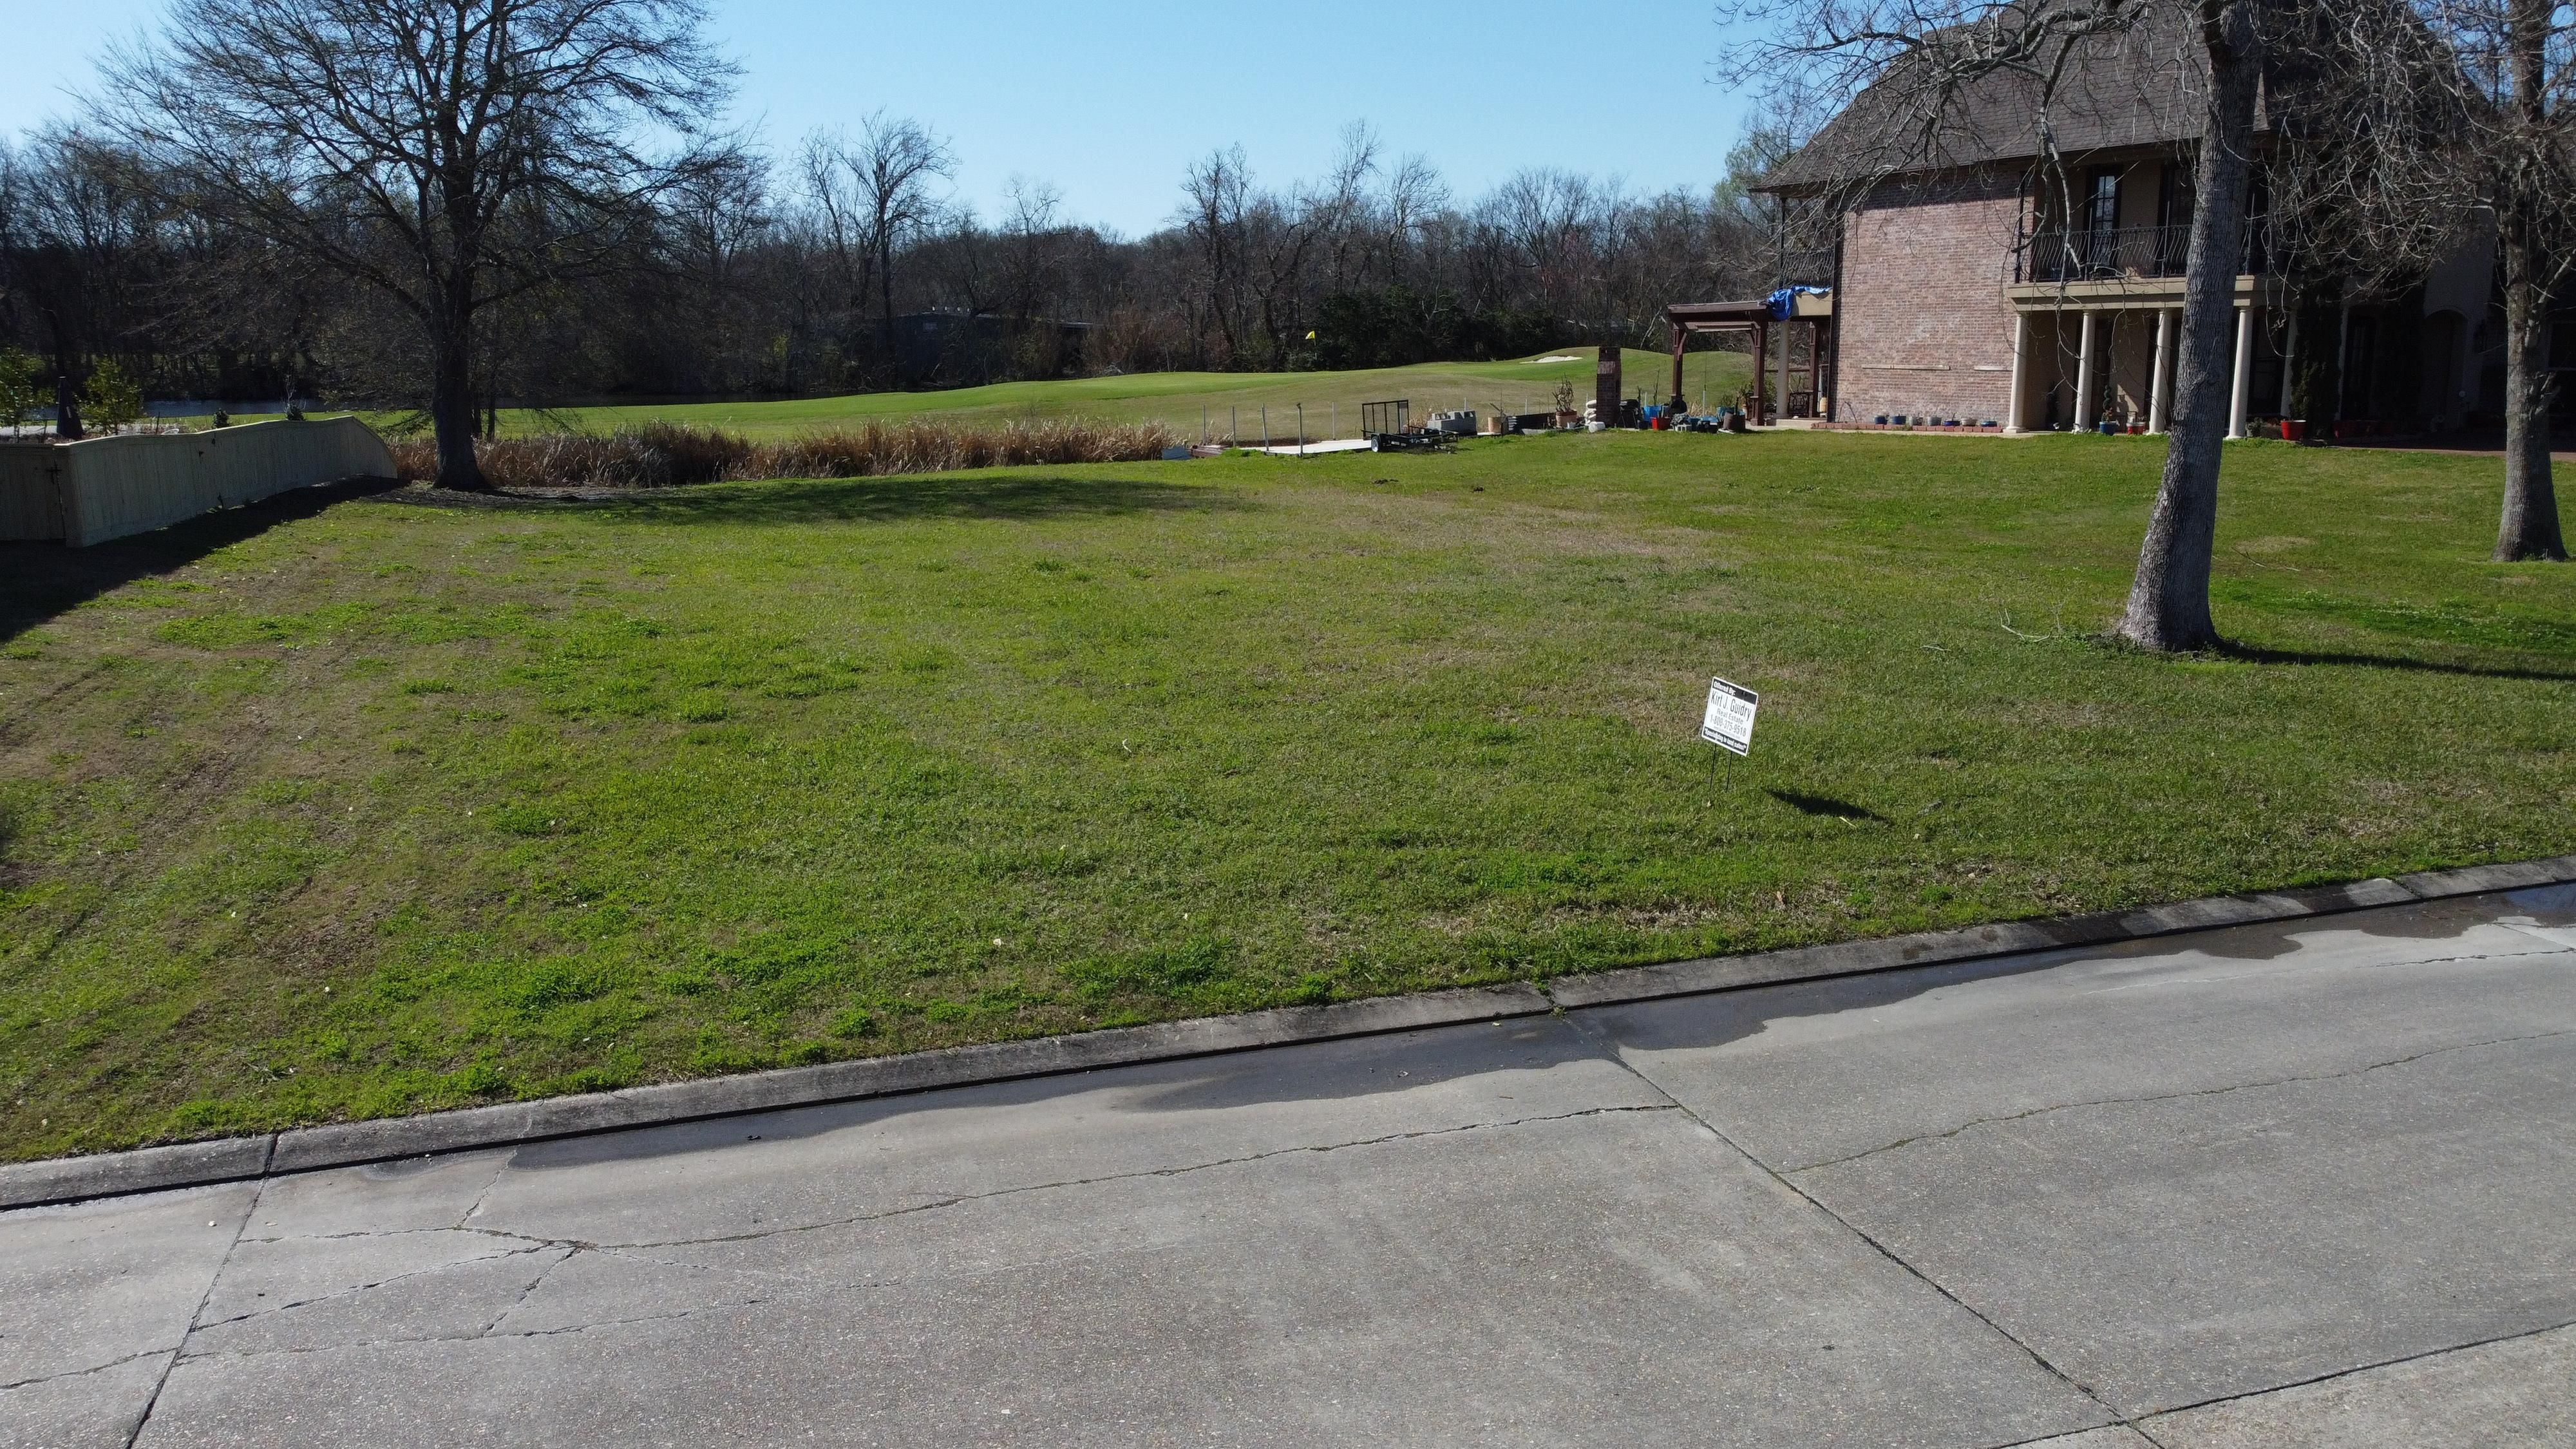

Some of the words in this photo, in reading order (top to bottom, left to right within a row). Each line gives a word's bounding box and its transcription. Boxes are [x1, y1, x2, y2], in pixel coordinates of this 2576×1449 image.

[1711, 691, 1723, 706] Kirt
[1730, 699, 1752, 721] Guidry
[1717, 708, 1727, 717] Real
[1728, 713, 1744, 724] Estate
